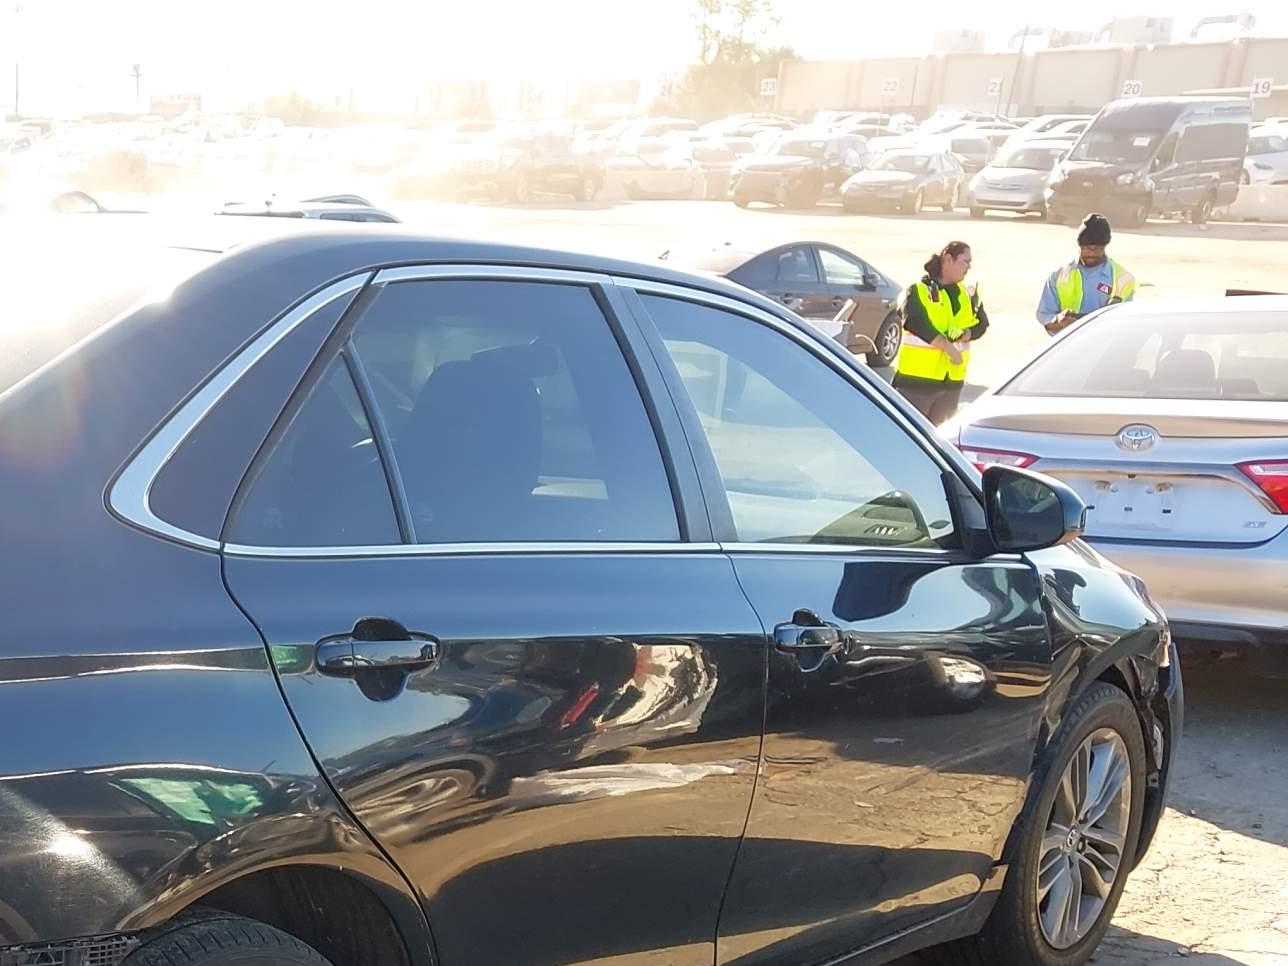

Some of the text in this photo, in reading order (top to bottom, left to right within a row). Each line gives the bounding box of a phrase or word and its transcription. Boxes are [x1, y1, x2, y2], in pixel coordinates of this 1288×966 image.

[883, 80, 898, 92] 22
[1123, 83, 1140, 95] 20
[1253, 81, 1271, 94] 19
